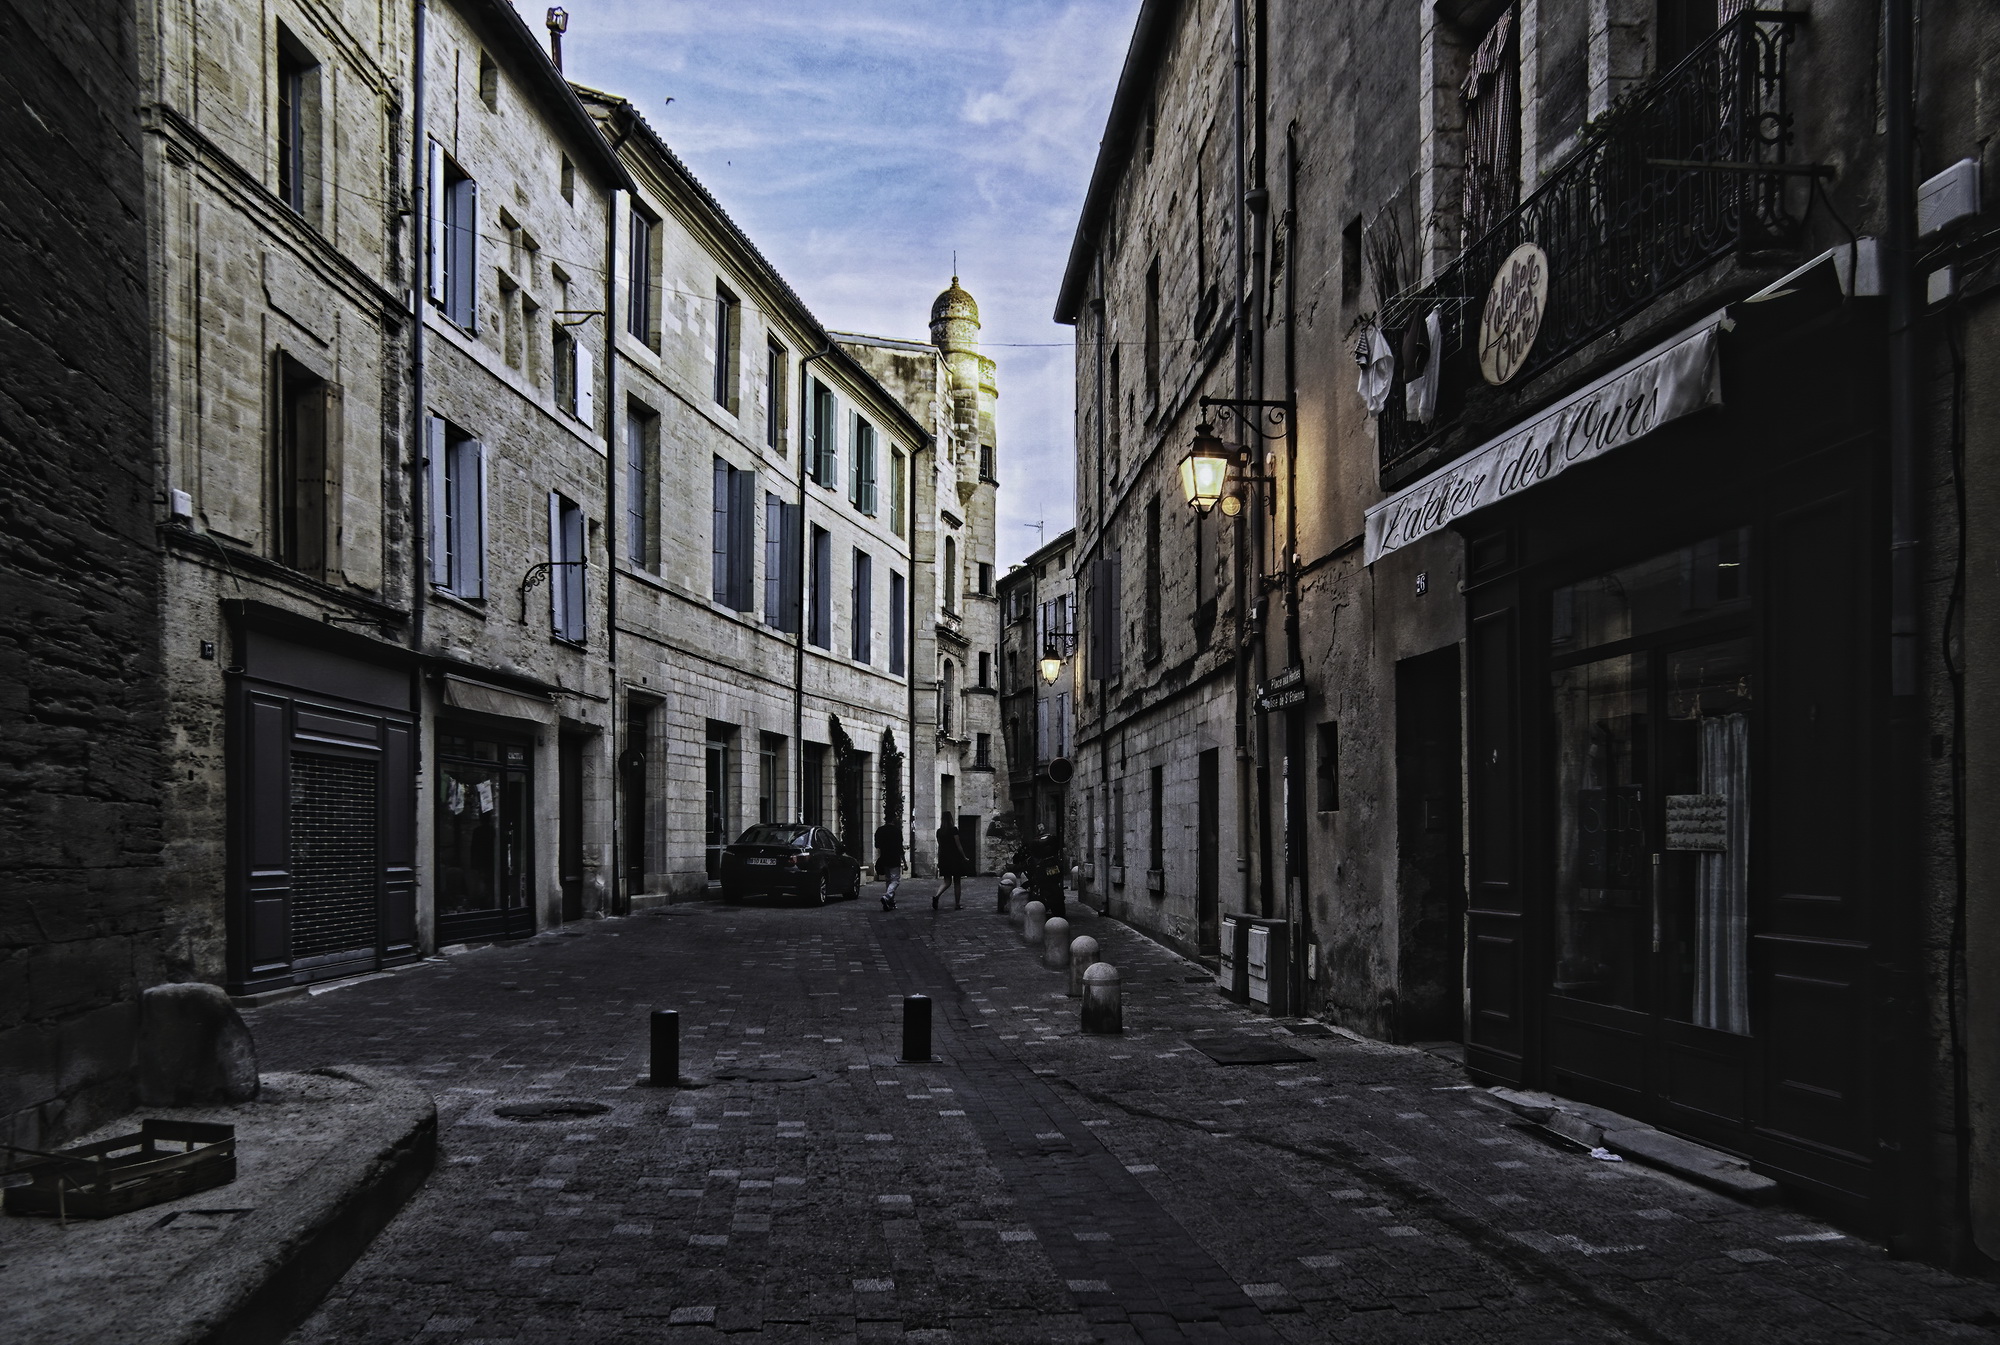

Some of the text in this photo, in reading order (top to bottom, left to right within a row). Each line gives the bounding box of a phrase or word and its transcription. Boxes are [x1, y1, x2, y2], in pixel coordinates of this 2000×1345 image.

[1507, 280, 1533, 333] des
[1496, 296, 1539, 382] Ours
[1380, 387, 1660, 553] L'atelier des Ours
[1271, 678, 1282, 690] Place
[1279, 694, 1285, 706] de
